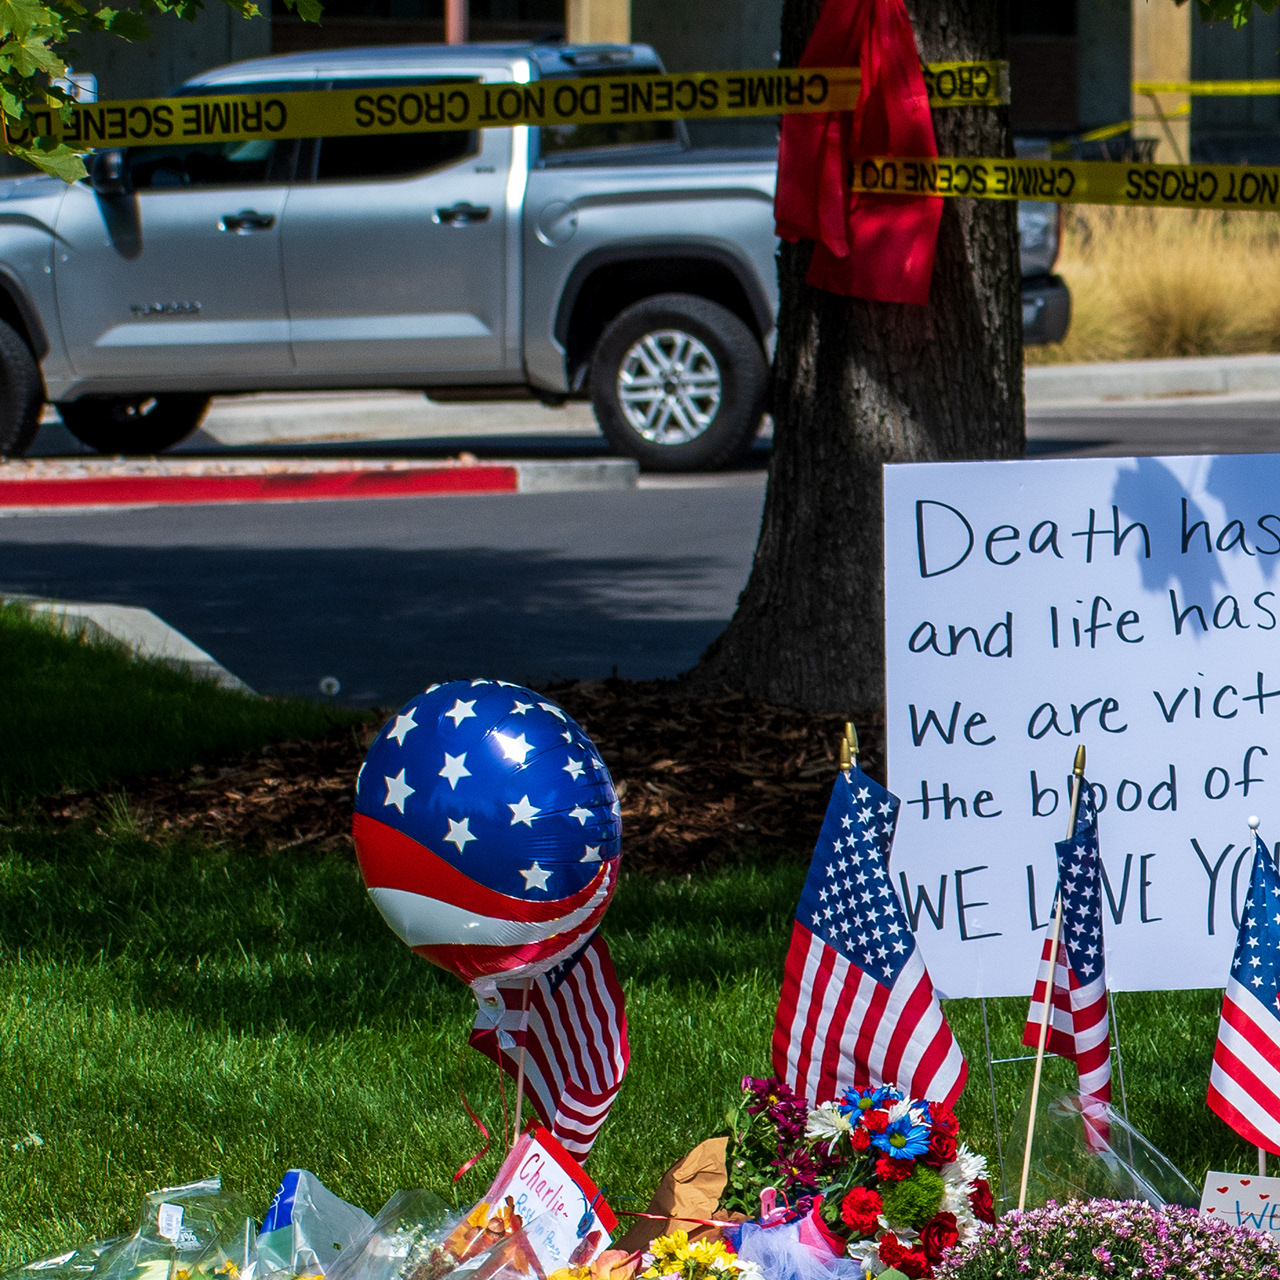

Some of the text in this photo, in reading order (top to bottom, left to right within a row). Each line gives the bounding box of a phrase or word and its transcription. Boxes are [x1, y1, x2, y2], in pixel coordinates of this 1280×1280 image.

[923, 66, 990, 97] CRO
[354, 74, 828, 128] CRIME SCENE DO NOT CROSS
[62, 106, 174, 141] SCENE
[183, 102, 288, 136] CRIME
[859, 165, 898, 190] DO
[903, 164, 988, 193] SCENE
[995, 167, 1076, 197] CRIME
[1127, 169, 1218, 202] CROSS
[1222, 172, 1278, 204] NOT
[916, 496, 1151, 579] Death
[908, 611, 1012, 658] and
[1050, 596, 1144, 648] life
[1169, 582, 1276, 636] has
[908, 701, 996, 747] We
[1027, 697, 1128, 740] are
[907, 780, 1002, 820] the
[1204, 746, 1268, 799] of
[900, 866, 1003, 941] WE
[1026, 853, 1162, 931] LVE
[516, 1193, 535, 1224] Rest
